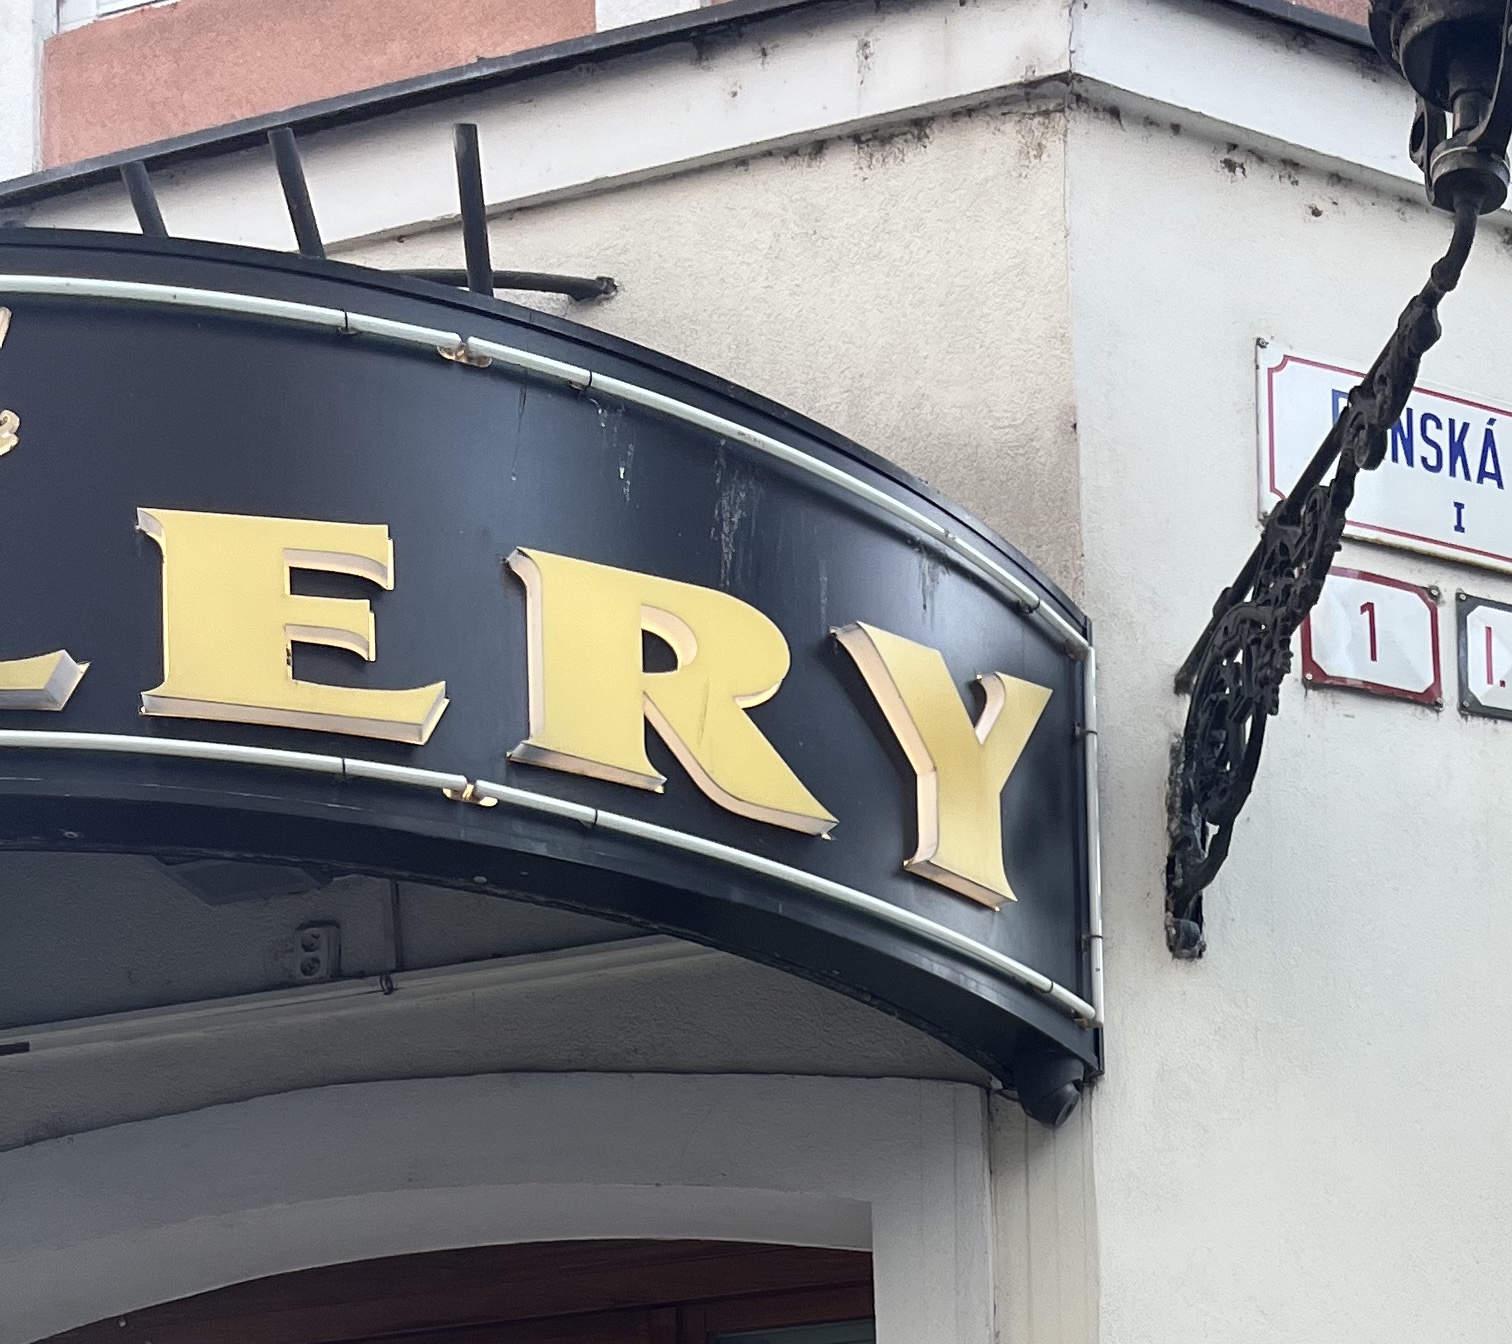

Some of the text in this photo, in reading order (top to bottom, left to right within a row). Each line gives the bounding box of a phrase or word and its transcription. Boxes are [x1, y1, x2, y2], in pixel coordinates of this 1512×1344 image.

[1331, 388, 1504, 491] NSKÁ
[1453, 501, 1466, 534] I
[1360, 602, 1378, 662] 1
[0, 506, 1053, 912] ERY
